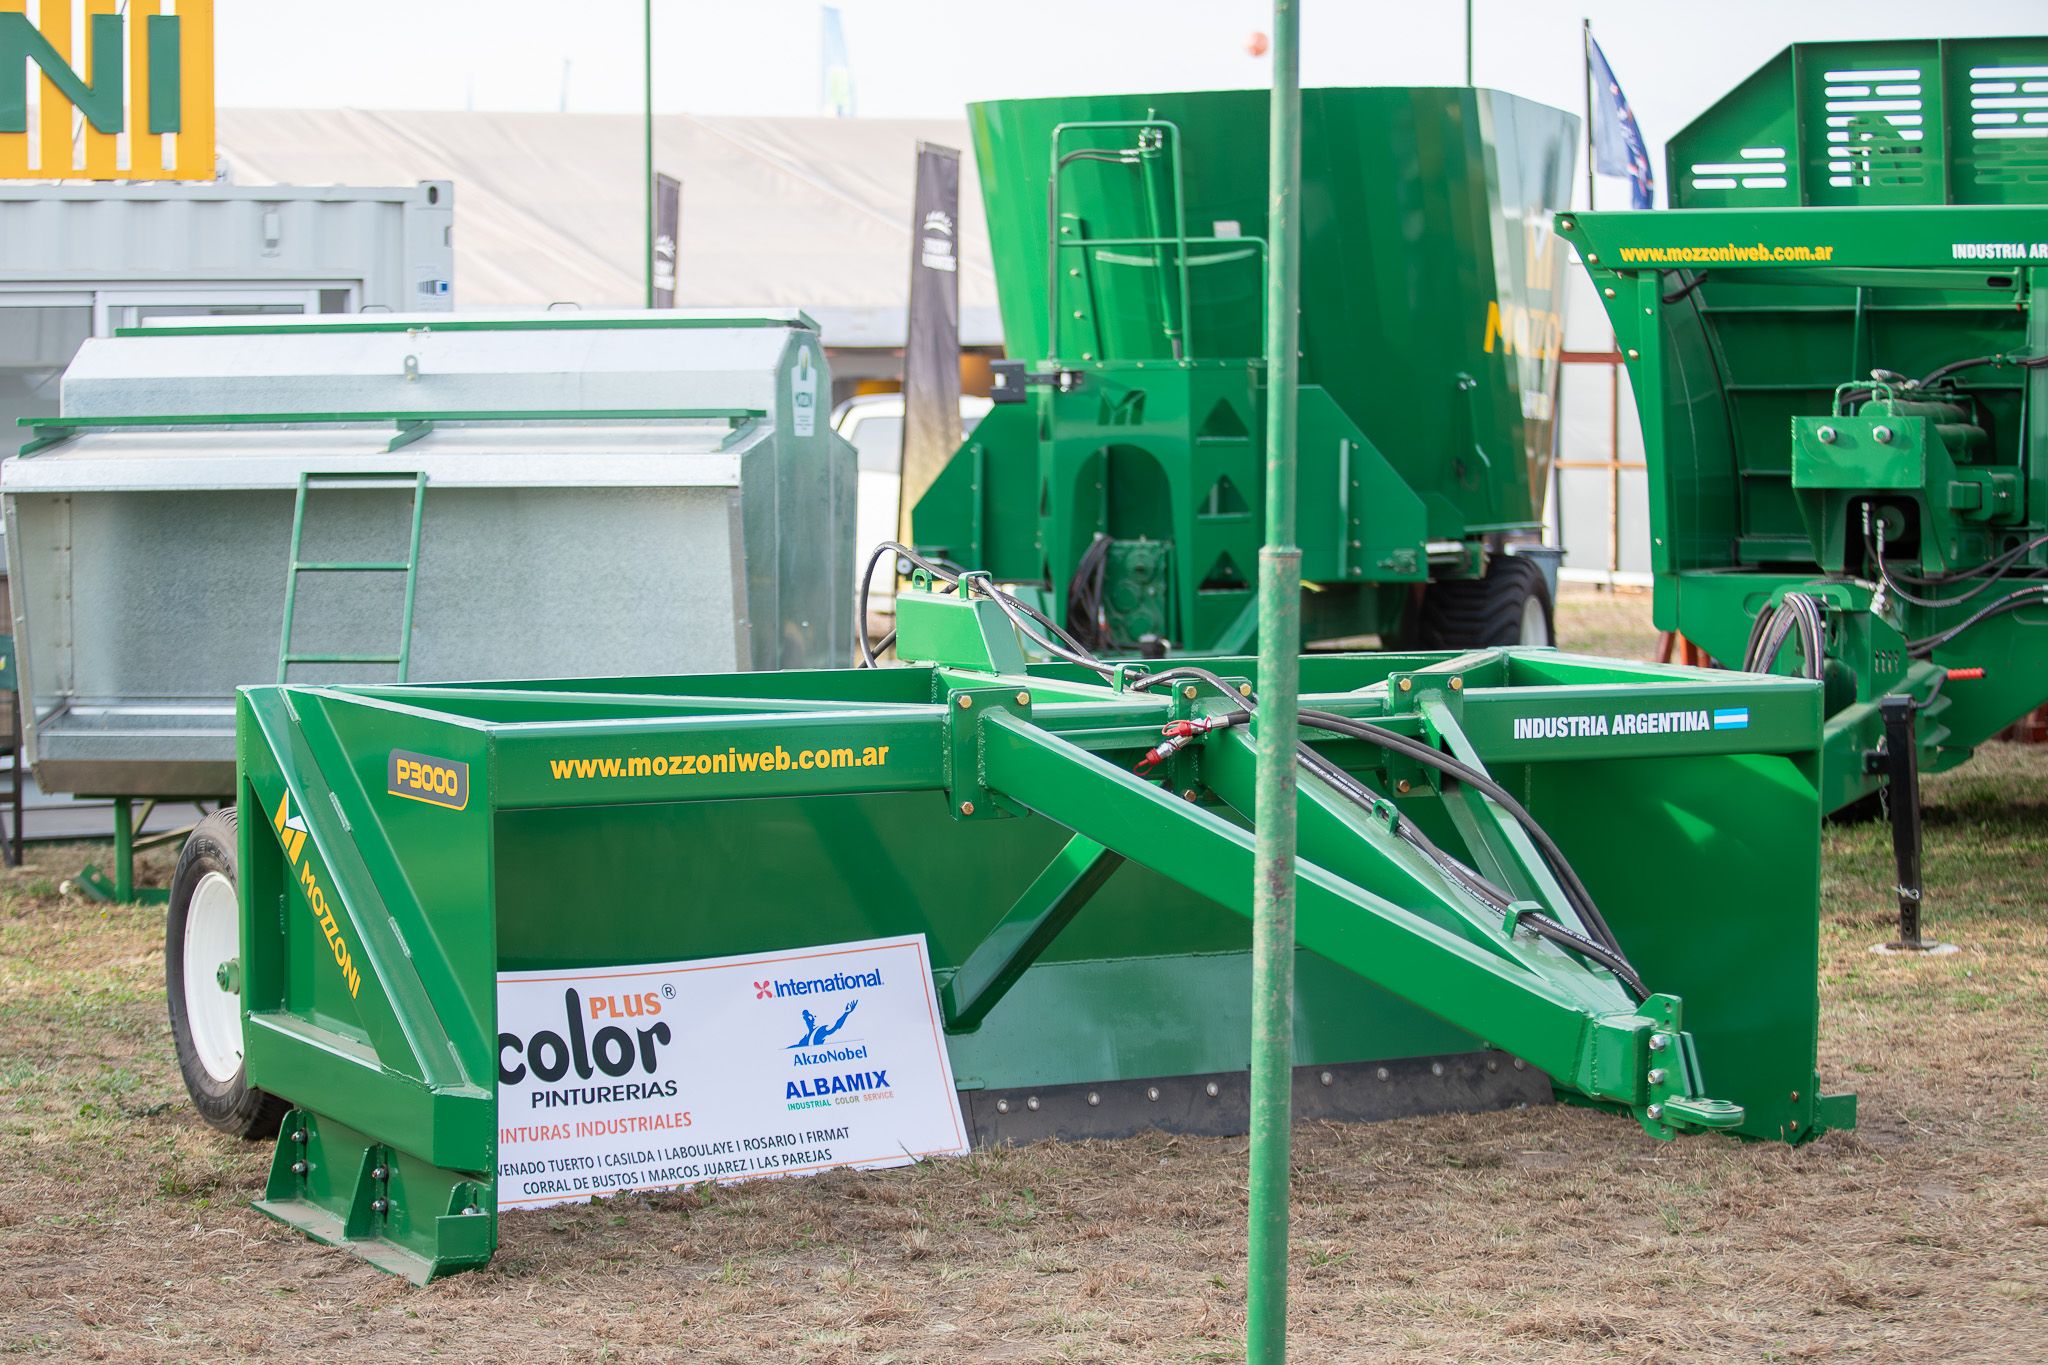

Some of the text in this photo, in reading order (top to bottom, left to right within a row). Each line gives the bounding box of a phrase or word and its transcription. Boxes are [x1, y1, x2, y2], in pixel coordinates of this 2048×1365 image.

[1619, 243, 1833, 262] www.mozzoniweb.com.ar
[1951, 243, 2027, 259] INDUSTRIA
[1513, 710, 1710, 740] INDUSTRIA ARGENTINA
[396, 758, 458, 797] P3000
[549, 745, 890, 780] www.mozzoniweb.com.ar
[300, 860, 361, 1000] MOZZONI
[774, 968, 882, 998] International
[589, 992, 662, 1019] PLUS
[498, 987, 672, 1086] color
[793, 1045, 868, 1067] AkzoNobel
[531, 1079, 678, 1109] PINTURERIAS
[785, 1070, 891, 1100] ALBAMIX
[787, 1090, 895, 1111] INDUSTRIAL COLOR SERVICE
[498, 1111, 693, 1145] INTURAS INDUSTRIALES
[497, 1160, 546, 1177] VENADO
[548, 1156, 595, 1173] TUERTO
[604, 1151, 656, 1167] CASILDA
[664, 1141, 734, 1161] LABOULAYE
[743, 1133, 797, 1151] ROSARIO
[806, 1126, 850, 1144] FIRMAT
[523, 1181, 572, 1195] CORRAL
[573, 1178, 590, 1190] DE
[592, 1172, 639, 1189] BUSTOS
[648, 1165, 700, 1182] MARCOS
[702, 1159, 747, 1176] JUAREZ
[757, 1154, 780, 1169] LAS
[782, 1148, 833, 1166] PAREJAS
